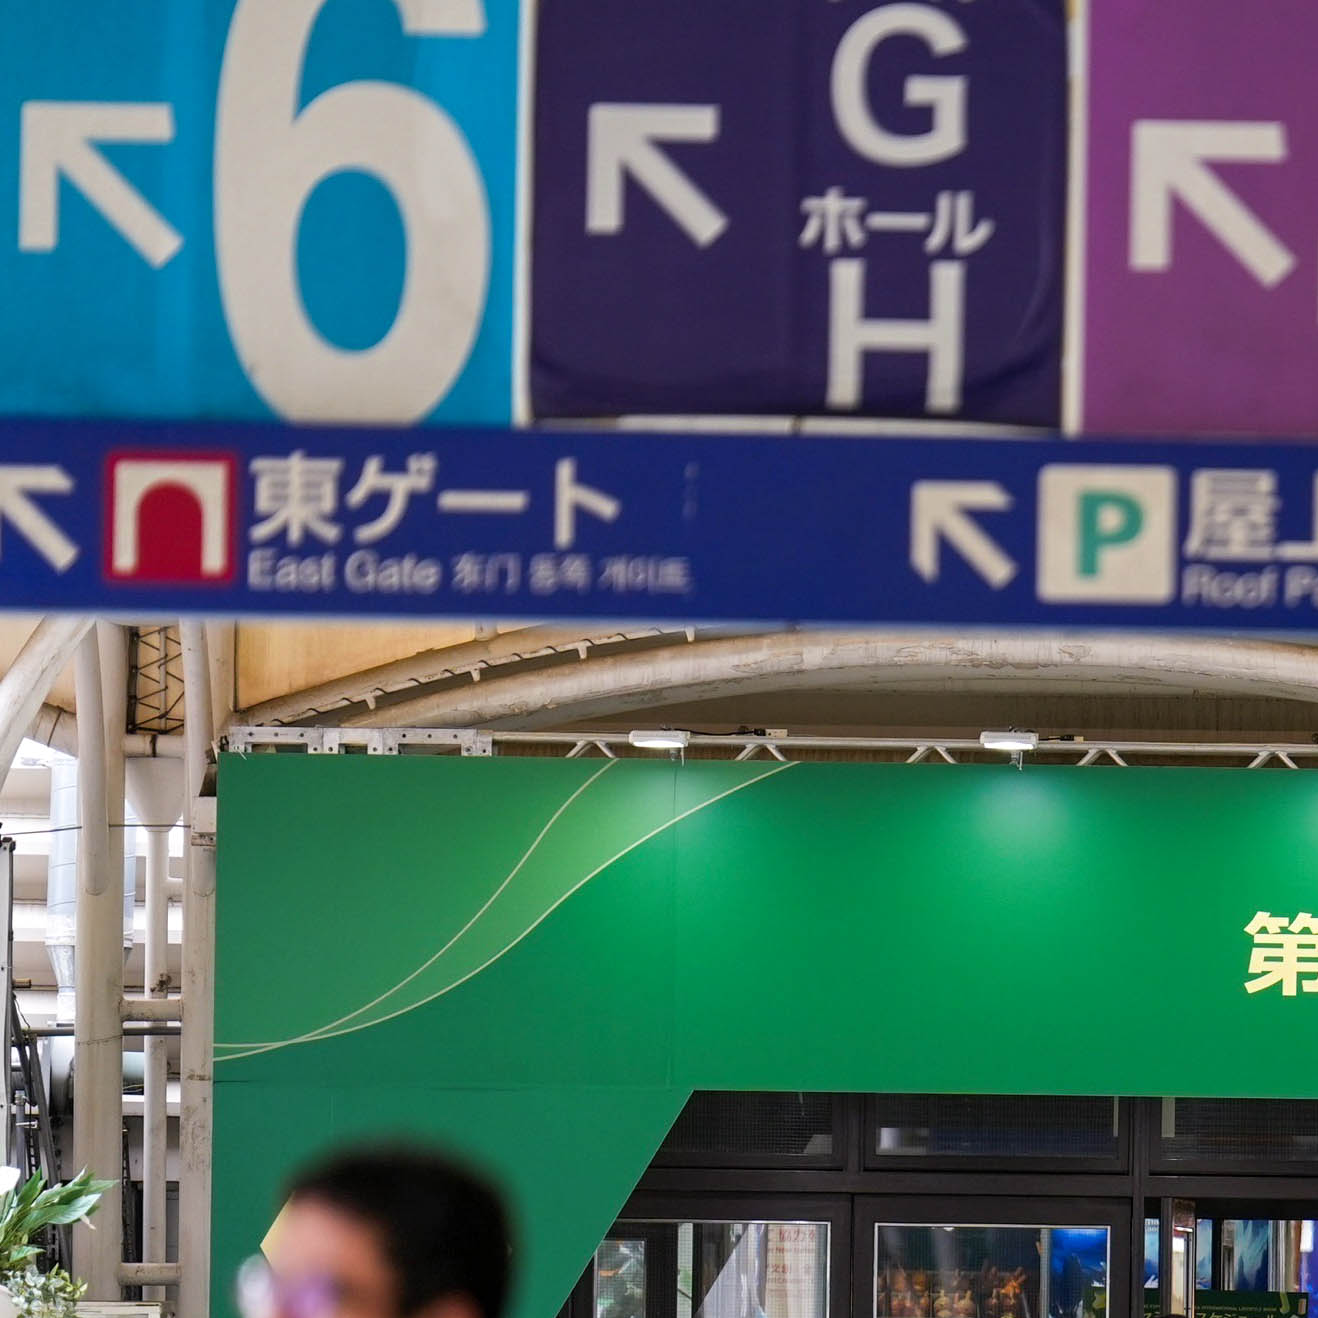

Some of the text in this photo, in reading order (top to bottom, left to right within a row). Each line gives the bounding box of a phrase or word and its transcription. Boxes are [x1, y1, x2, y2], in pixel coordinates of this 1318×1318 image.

[831, 3, 967, 166] G
[214, 0, 491, 425] 6
[800, 187, 993, 254] ホール
[827, 258, 964, 410] H
[249, 450, 621, 549] 東ゲート
[1077, 490, 1145, 578] P
[248, 549, 442, 592] East Gate
[1182, 565, 1279, 608] Roof
